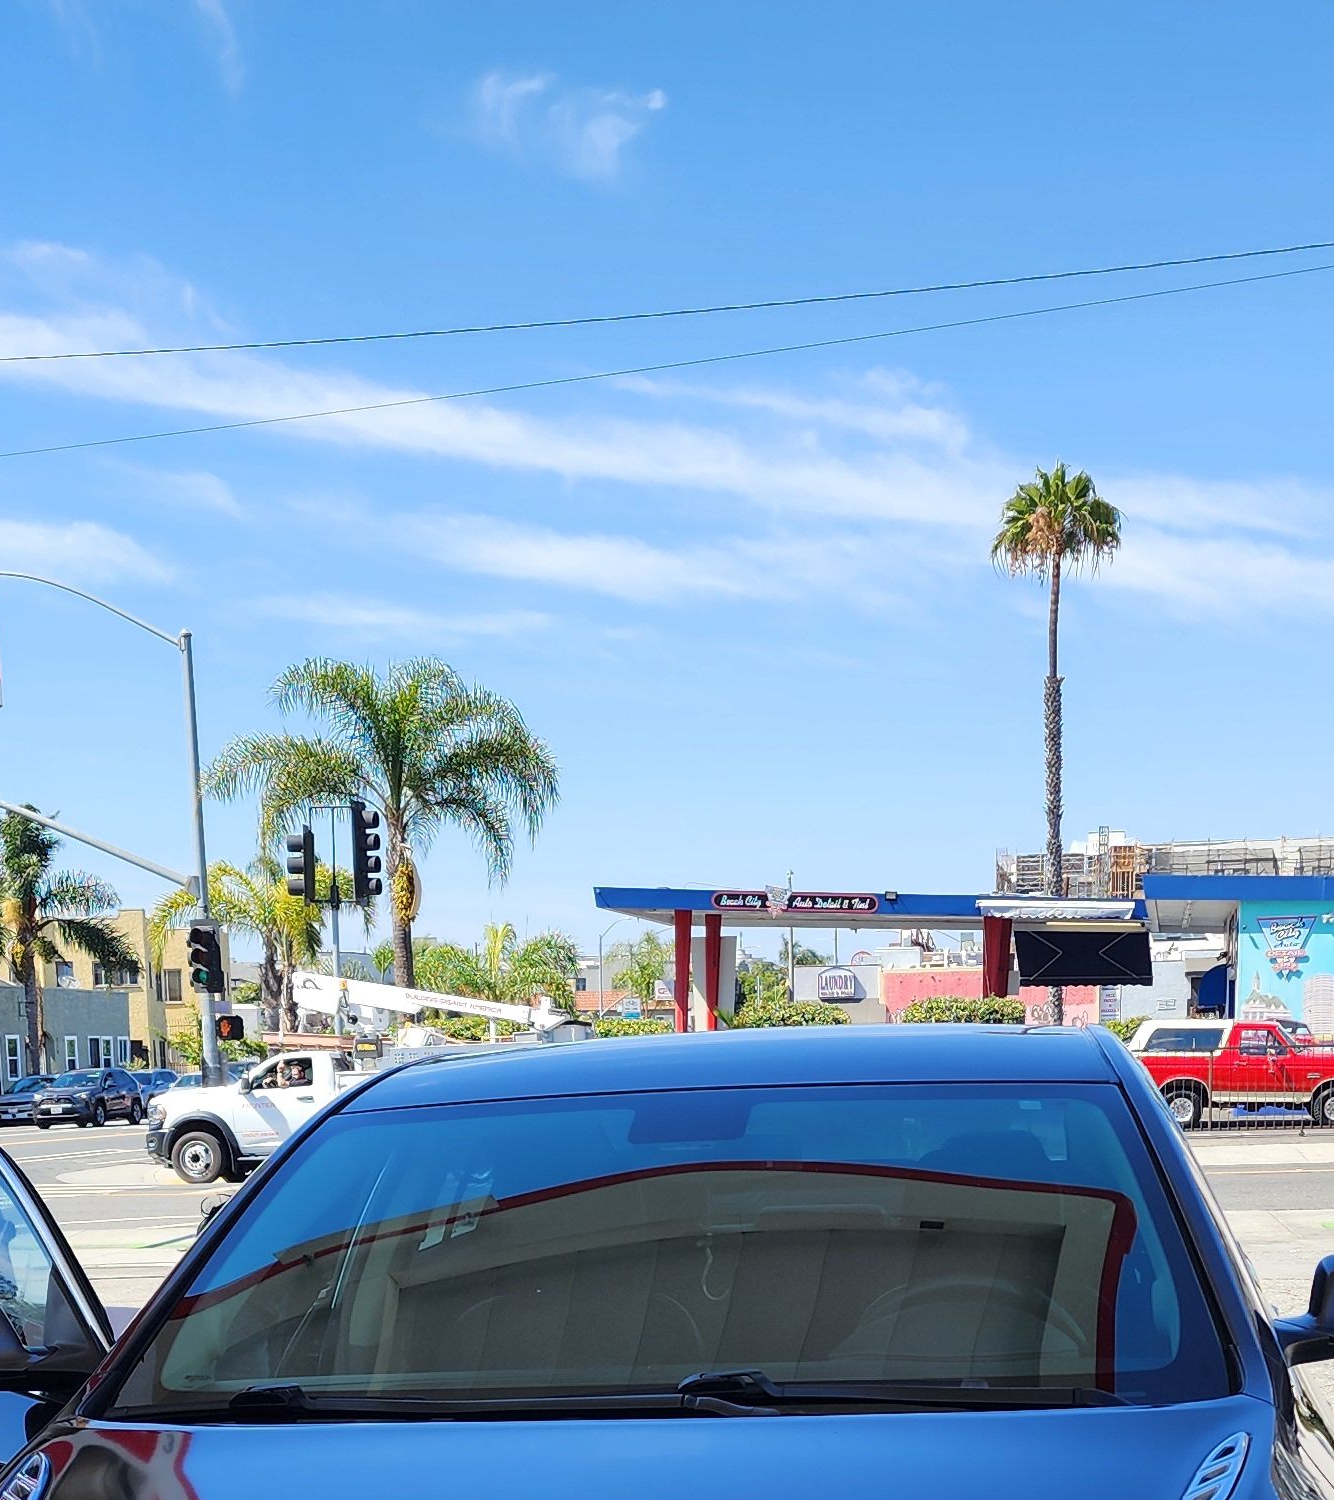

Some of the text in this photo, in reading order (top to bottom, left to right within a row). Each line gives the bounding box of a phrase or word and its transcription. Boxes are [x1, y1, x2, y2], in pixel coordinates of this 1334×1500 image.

[720, 895, 743, 906] Beach
[744, 895, 762, 909] City
[792, 897, 813, 908] Auto
[814, 897, 841, 909] Detail
[851, 899, 870, 910] Tint
[1269, 917, 1305, 934] Beach
[1275, 928, 1301, 941] City
[820, 975, 854, 990] LAUNDRY
